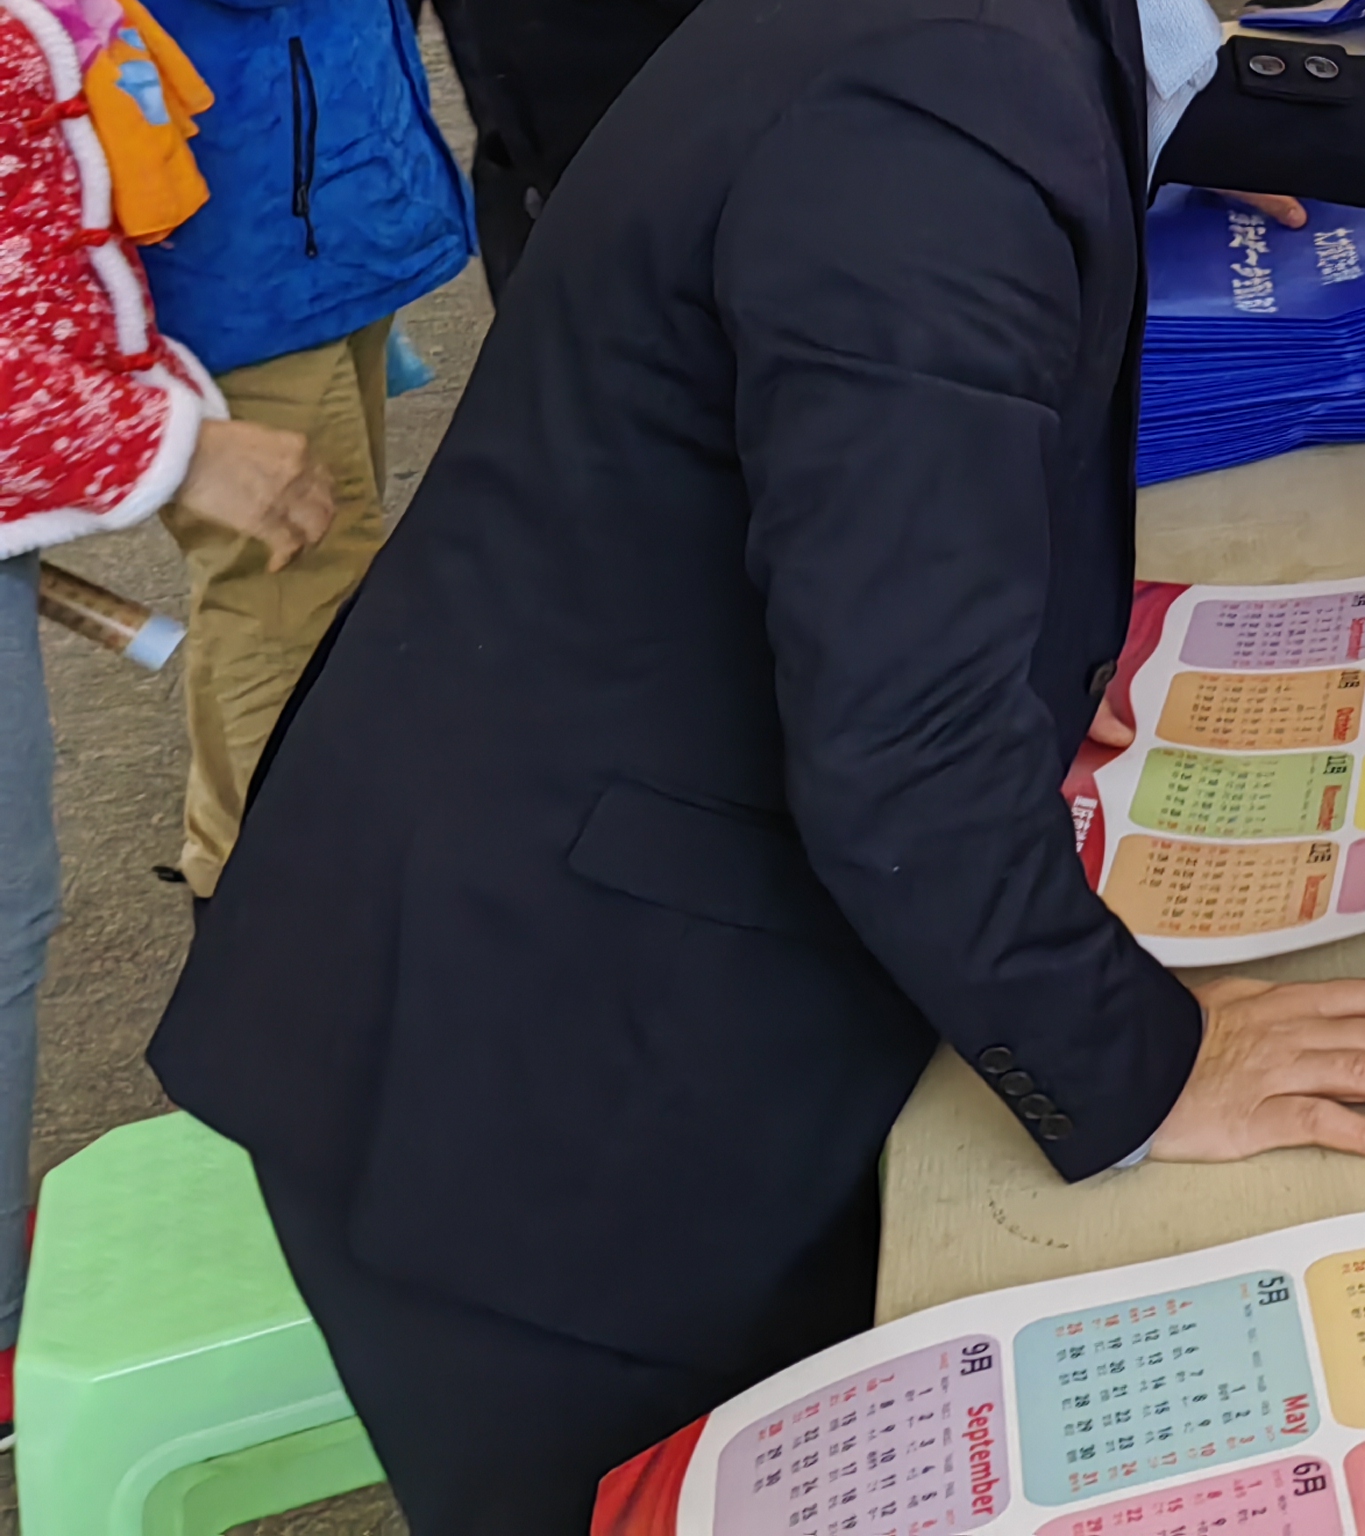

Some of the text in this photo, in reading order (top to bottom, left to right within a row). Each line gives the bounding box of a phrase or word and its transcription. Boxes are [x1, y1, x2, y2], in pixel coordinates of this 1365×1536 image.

[1258, 1276, 1289, 1306] 5月
[960, 1341, 993, 1376] 9月
[1281, 1393, 1310, 1436] May
[961, 1401, 1000, 1516] September
[1292, 1461, 1327, 1497] 6月
